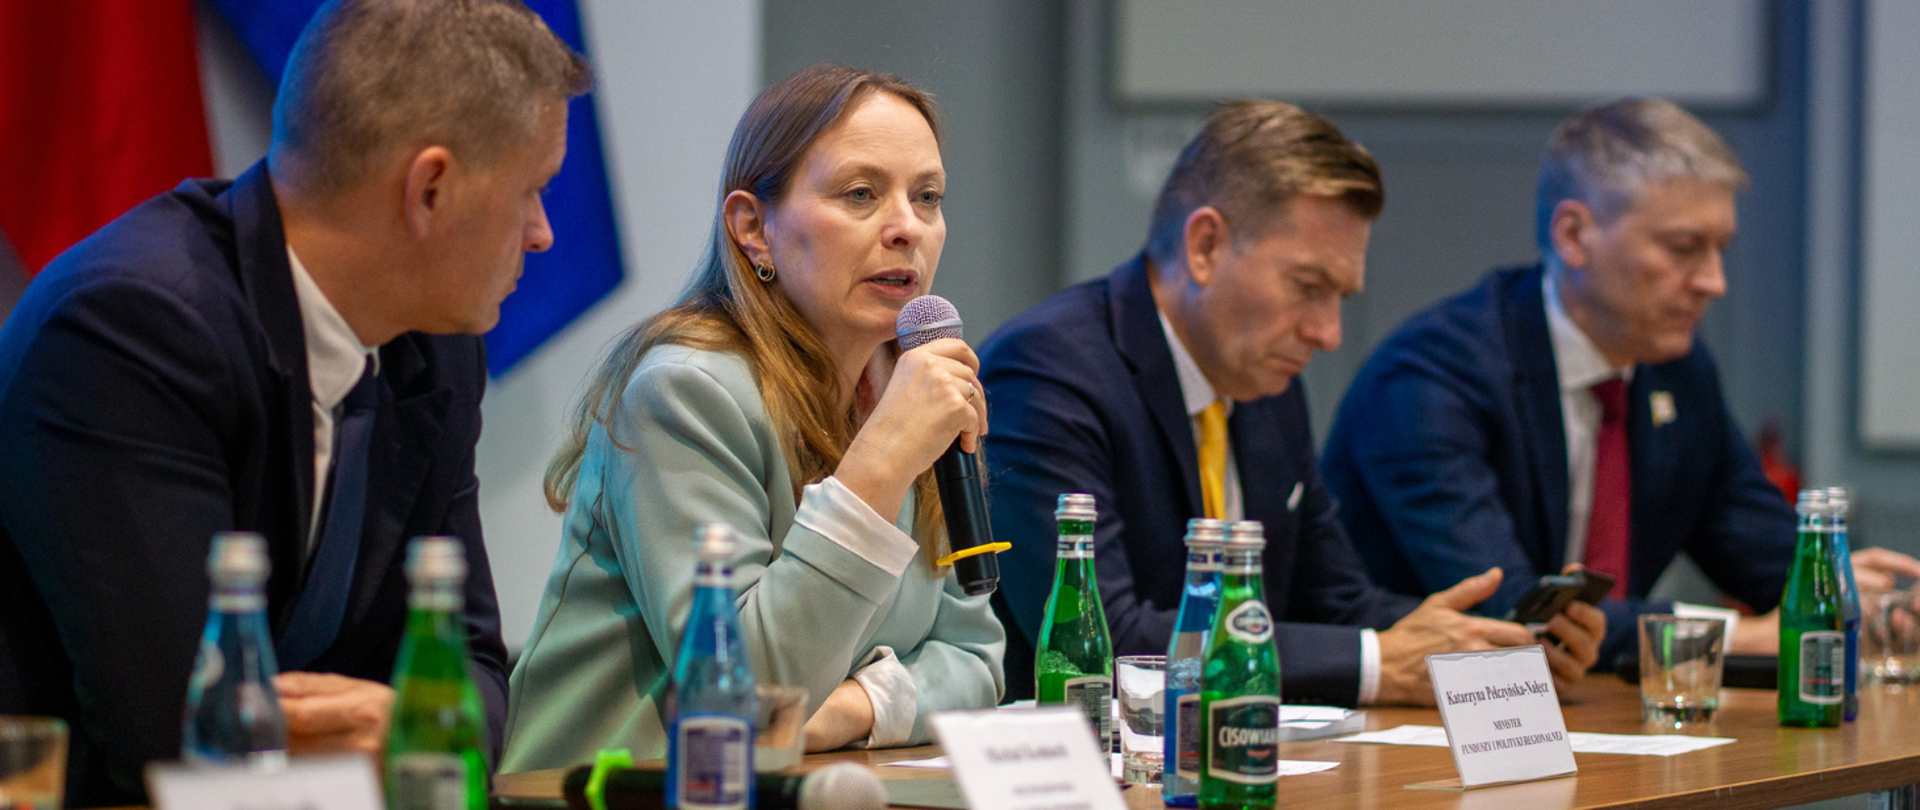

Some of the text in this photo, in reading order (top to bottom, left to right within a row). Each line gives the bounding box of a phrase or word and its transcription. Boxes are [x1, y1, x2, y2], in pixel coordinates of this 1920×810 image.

[1446, 690, 1486, 706] Katarzyna
[1493, 718, 1522, 730] MINISTER
[1461, 741, 1492, 755] FUNDUSZY
[1496, 736, 1524, 750] POLITYKI
[1524, 731, 1563, 745] REGIONALNEJ
